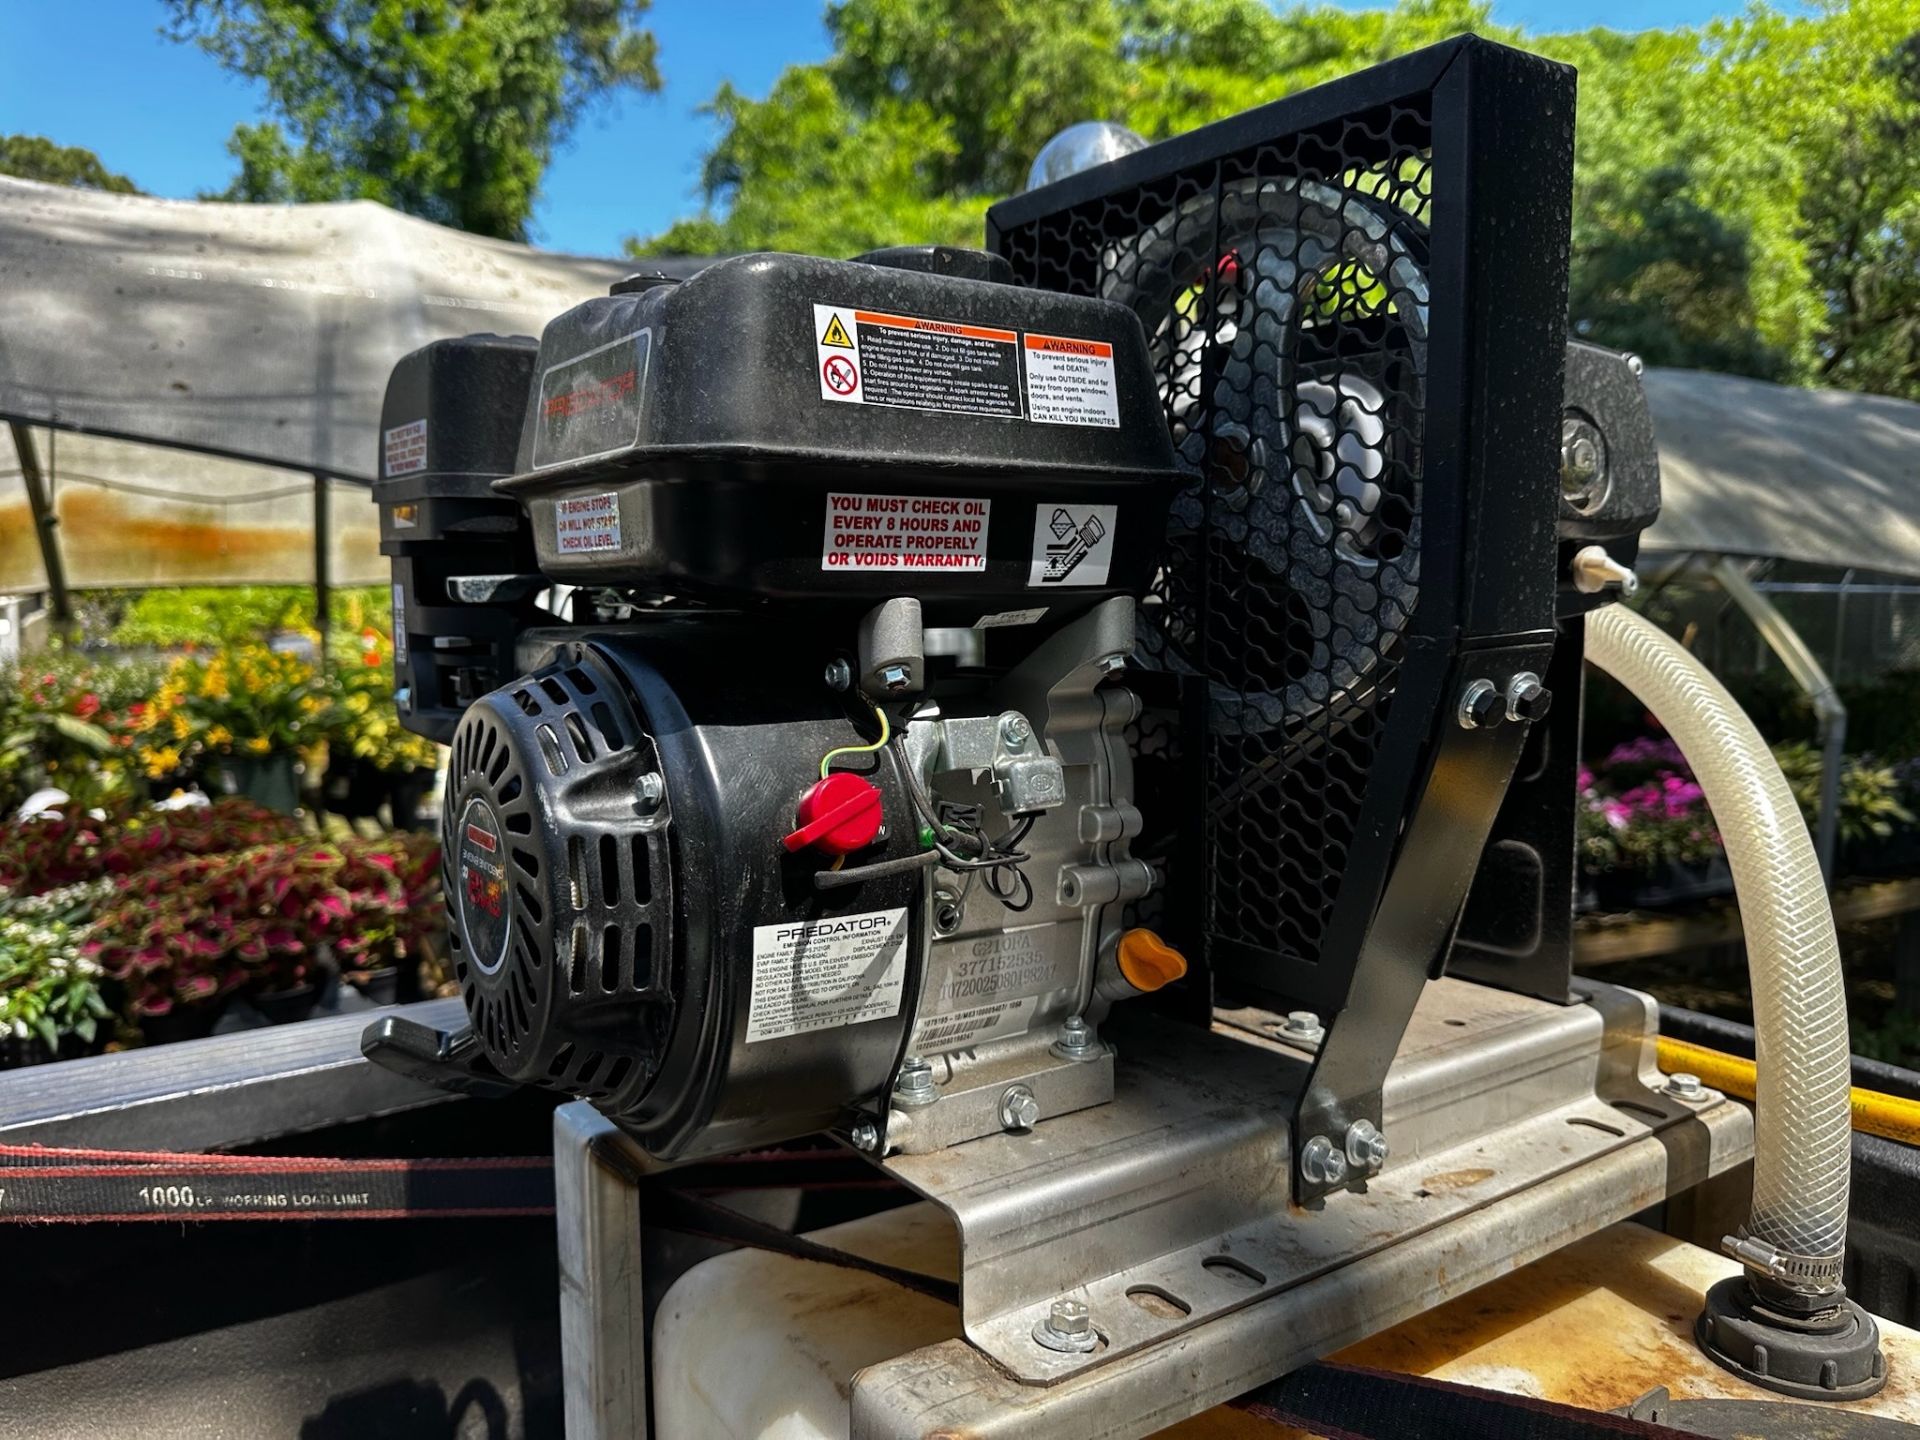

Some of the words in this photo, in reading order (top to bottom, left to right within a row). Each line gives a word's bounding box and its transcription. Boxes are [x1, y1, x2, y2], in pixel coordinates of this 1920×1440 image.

[920, 322, 962, 334] WARNING
[1050, 340, 1096, 355] WARNING
[1042, 353, 1065, 362] prevent
[1067, 356, 1089, 364] serious
[1090, 359, 1107, 367] injury
[1029, 373, 1044, 381] Only
[1058, 376, 1086, 384] OUTSIDE
[1064, 386, 1079, 394] open
[1032, 404, 1050, 412] Using
[1061, 406, 1082, 415] engine
[569, 500, 590, 513] ENGINE
[591, 496, 611, 511] STOPS
[831, 497, 862, 511] YOU
[867, 499, 908, 513] MUST
[912, 500, 960, 515] CHECK
[964, 502, 986, 515] OIL
[559, 521, 566, 532] OR
[568, 519, 582, 531] WILL
[583, 517, 595, 530] NOT
[833, 516, 882, 530] EVERY
[887, 517, 895, 530] 8
[900, 518, 949, 532] HOURS
[952, 519, 981, 532] AND
[563, 536, 582, 549] CHECK
[583, 536, 593, 548] OIL
[834, 534, 902, 548] OPERATE
[906, 536, 978, 549] PROPERLY
[828, 552, 849, 565] OR
[854, 553, 898, 565] VOIDS
[783, 940, 812, 949] EMISSION
[813, 936, 841, 945] CONTROL
[842, 930, 881, 940] INFORMATION
[139, 1186, 193, 1207] 1000
[222, 1194, 288, 1207] WORKING
[333, 1192, 370, 1206] LIMIT
